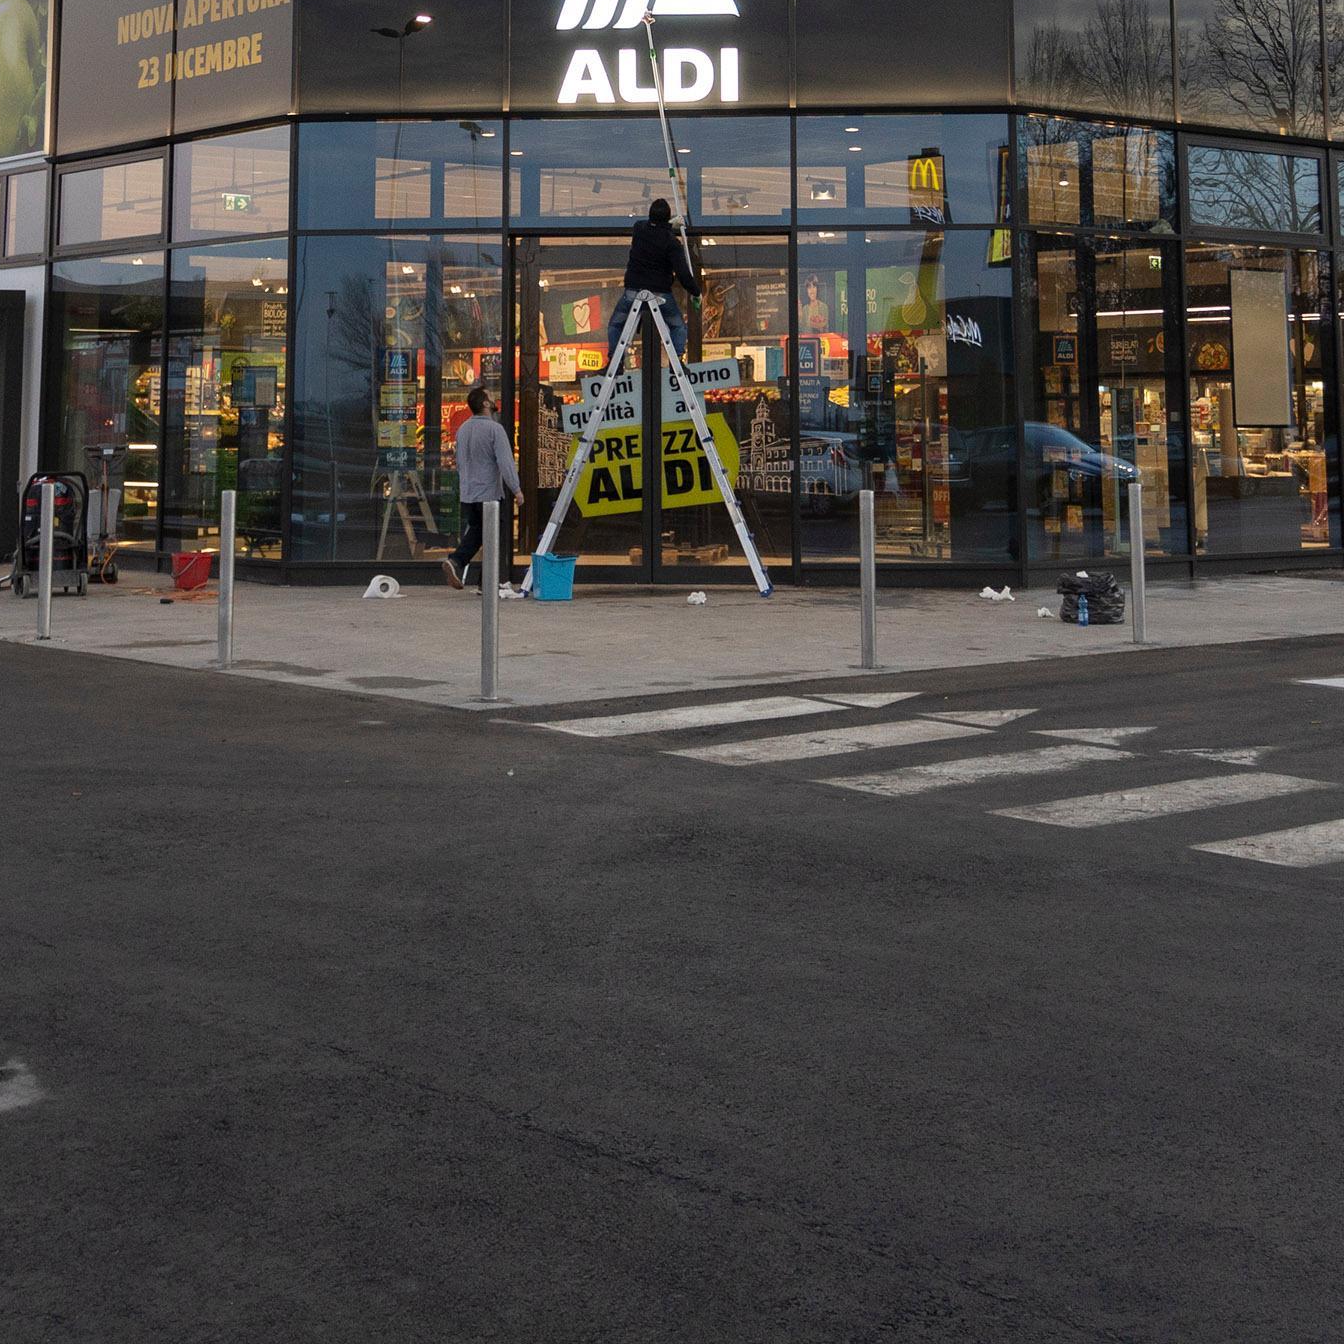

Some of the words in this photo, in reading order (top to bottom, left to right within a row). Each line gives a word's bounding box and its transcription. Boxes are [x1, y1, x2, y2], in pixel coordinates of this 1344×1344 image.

[117, 2, 178, 46] NUOVA
[137, 56, 160, 89] 23
[164, 32, 263, 84] DICEMBRE
[557, 47, 739, 104] ALDI
[582, 359, 599, 367] ALDI
[669, 367, 731, 392] gorno
[799, 361, 814, 369] LDI
[569, 401, 635, 429] qulità
[587, 456, 714, 505] ALDI
